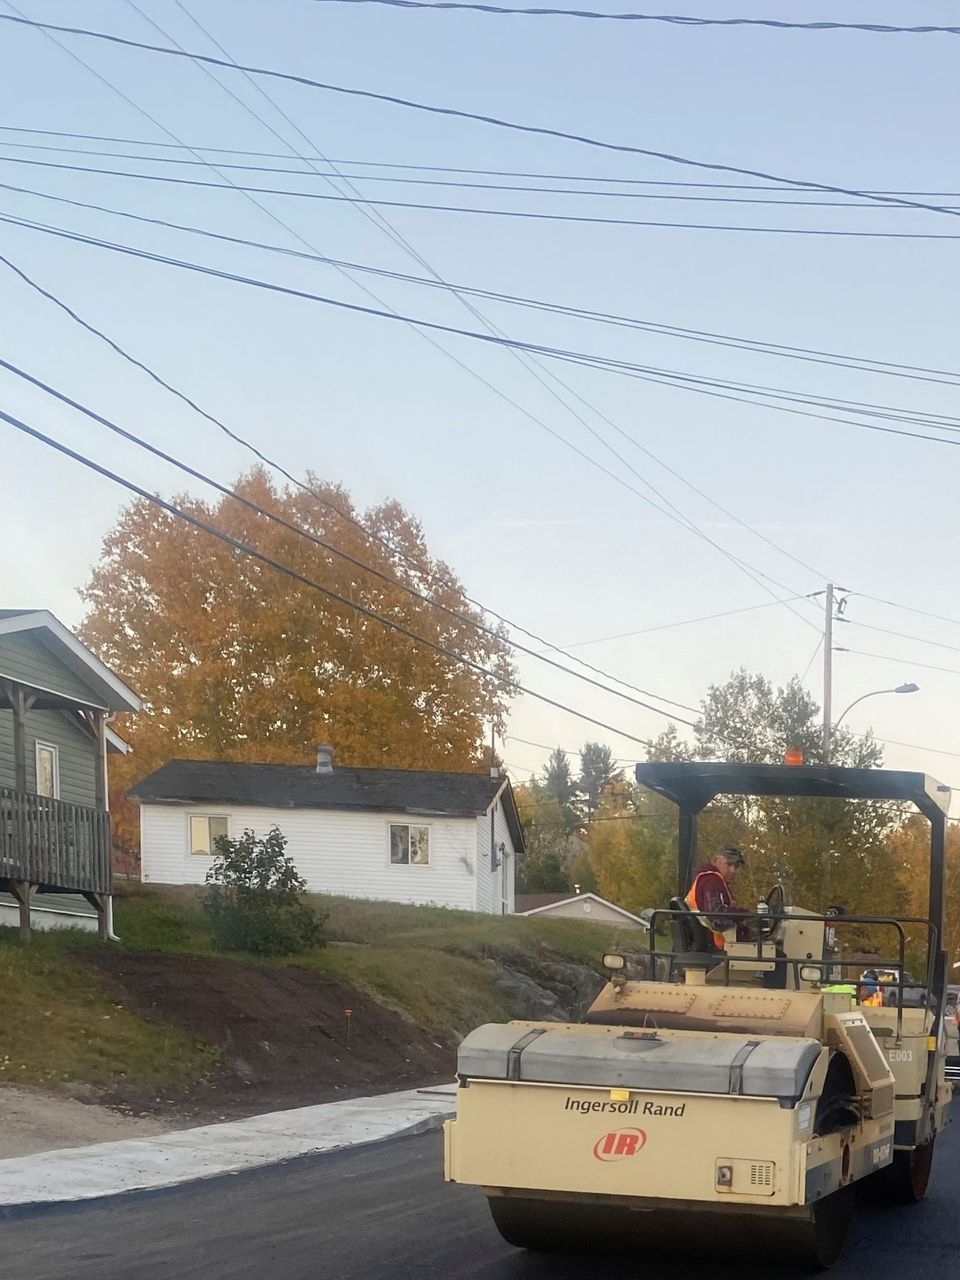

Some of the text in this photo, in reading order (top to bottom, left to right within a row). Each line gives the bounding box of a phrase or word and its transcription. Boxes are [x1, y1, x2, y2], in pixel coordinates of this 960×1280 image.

[888, 1049, 913, 1062] E003
[564, 1096, 686, 1117] Ingersoll Rand
[602, 1132, 640, 1157] IR
